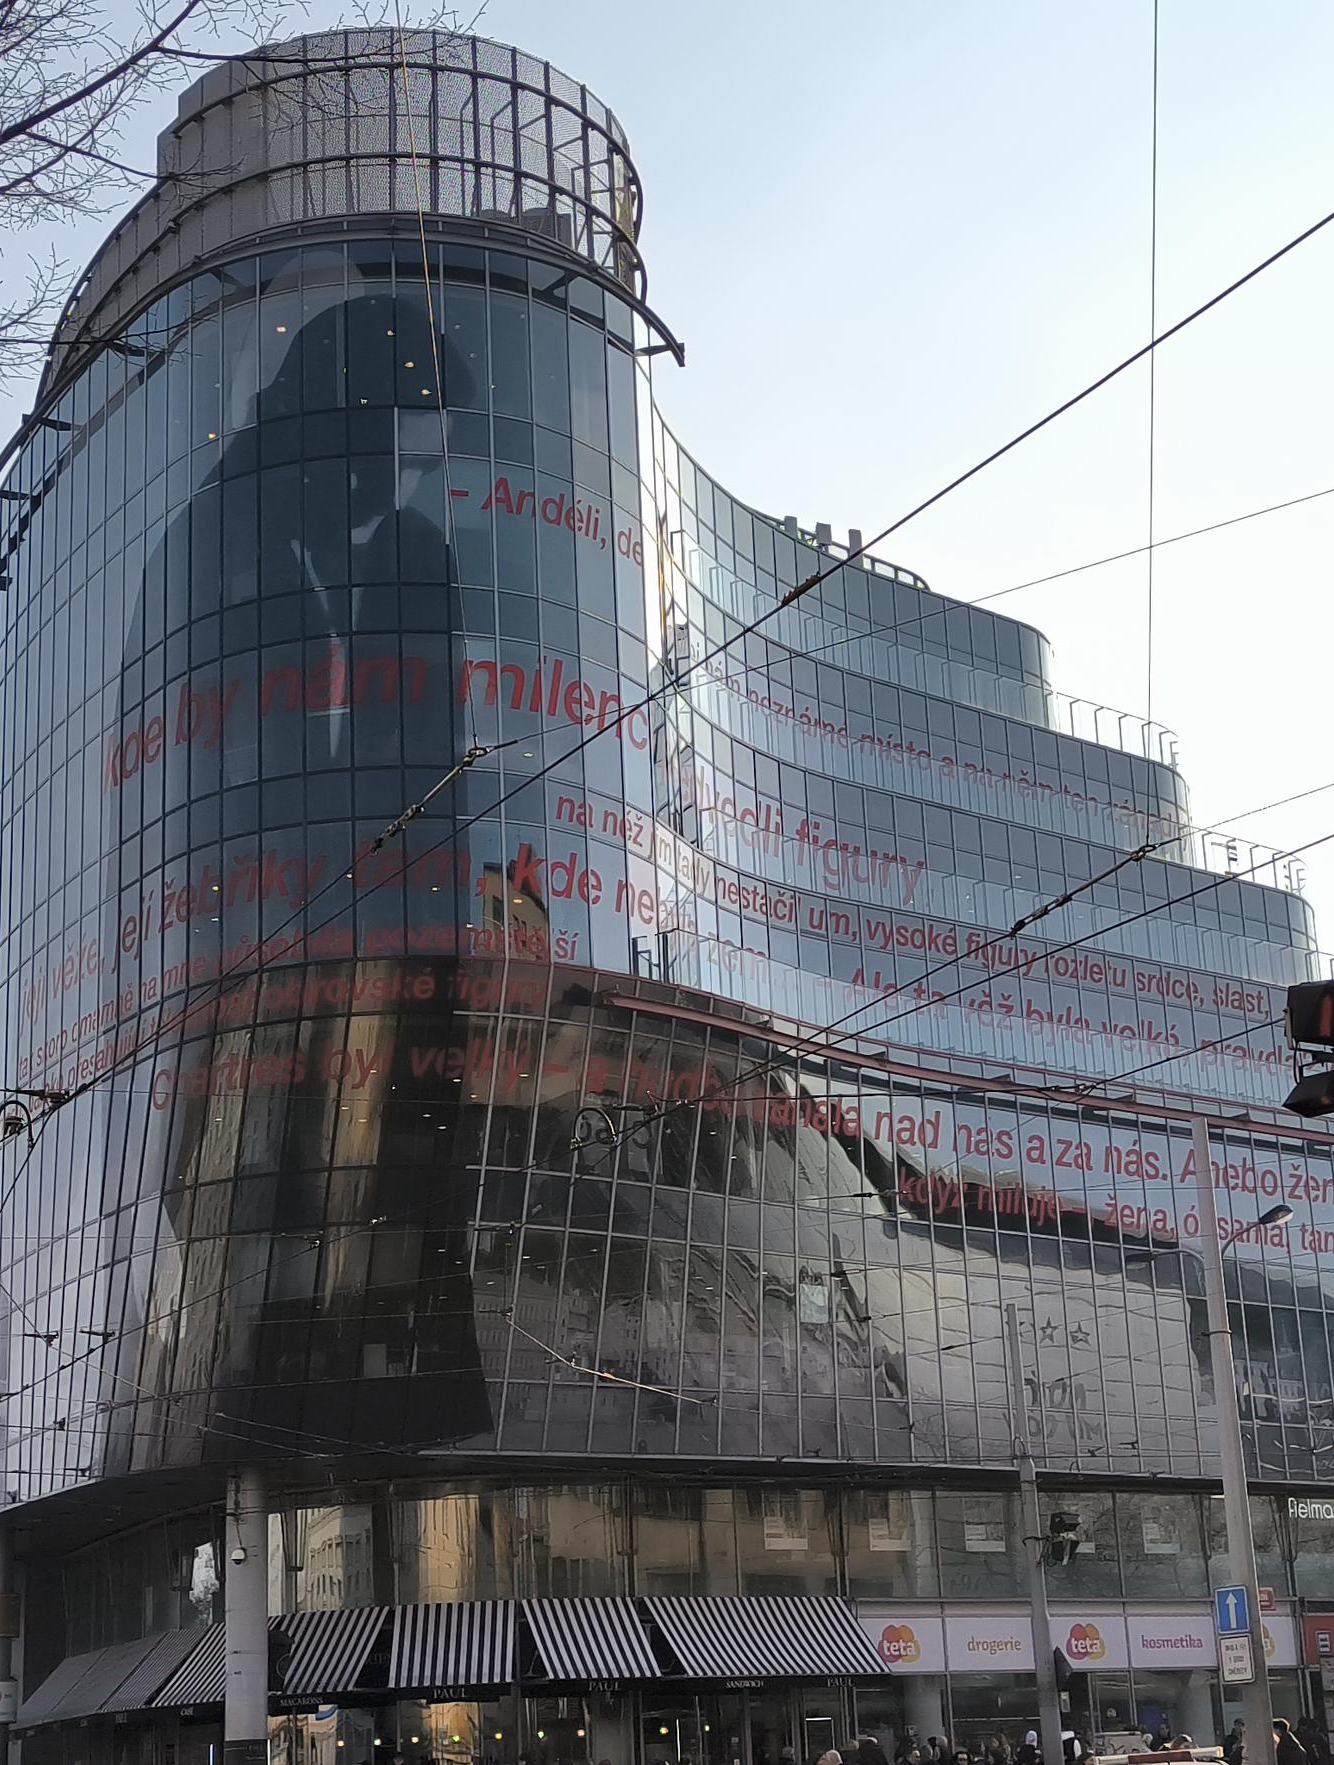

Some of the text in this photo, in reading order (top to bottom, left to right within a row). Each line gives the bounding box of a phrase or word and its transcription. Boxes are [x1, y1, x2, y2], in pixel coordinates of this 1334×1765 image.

[513, 841, 604, 906] kde
[555, 795, 594, 829] na
[866, 917, 958, 957] vysoké
[965, 931, 1037, 976] figury
[1043, 952, 1128, 989] rozletu
[1136, 969, 1206, 1009] srdce,
[1211, 982, 1270, 1021] slast,
[874, 1110, 941, 1150] nad
[1025, 1134, 1046, 1166] a
[1054, 1137, 1094, 1172] za
[1104, 1139, 1168, 1182] nás.
[1104, 1192, 1177, 1241] žena,
[882, 1638, 917, 1658] teta
[967, 1635, 1022, 1655] drogerie
[1070, 1636, 1102, 1654] teta
[1141, 1634, 1204, 1650] kosmetika
